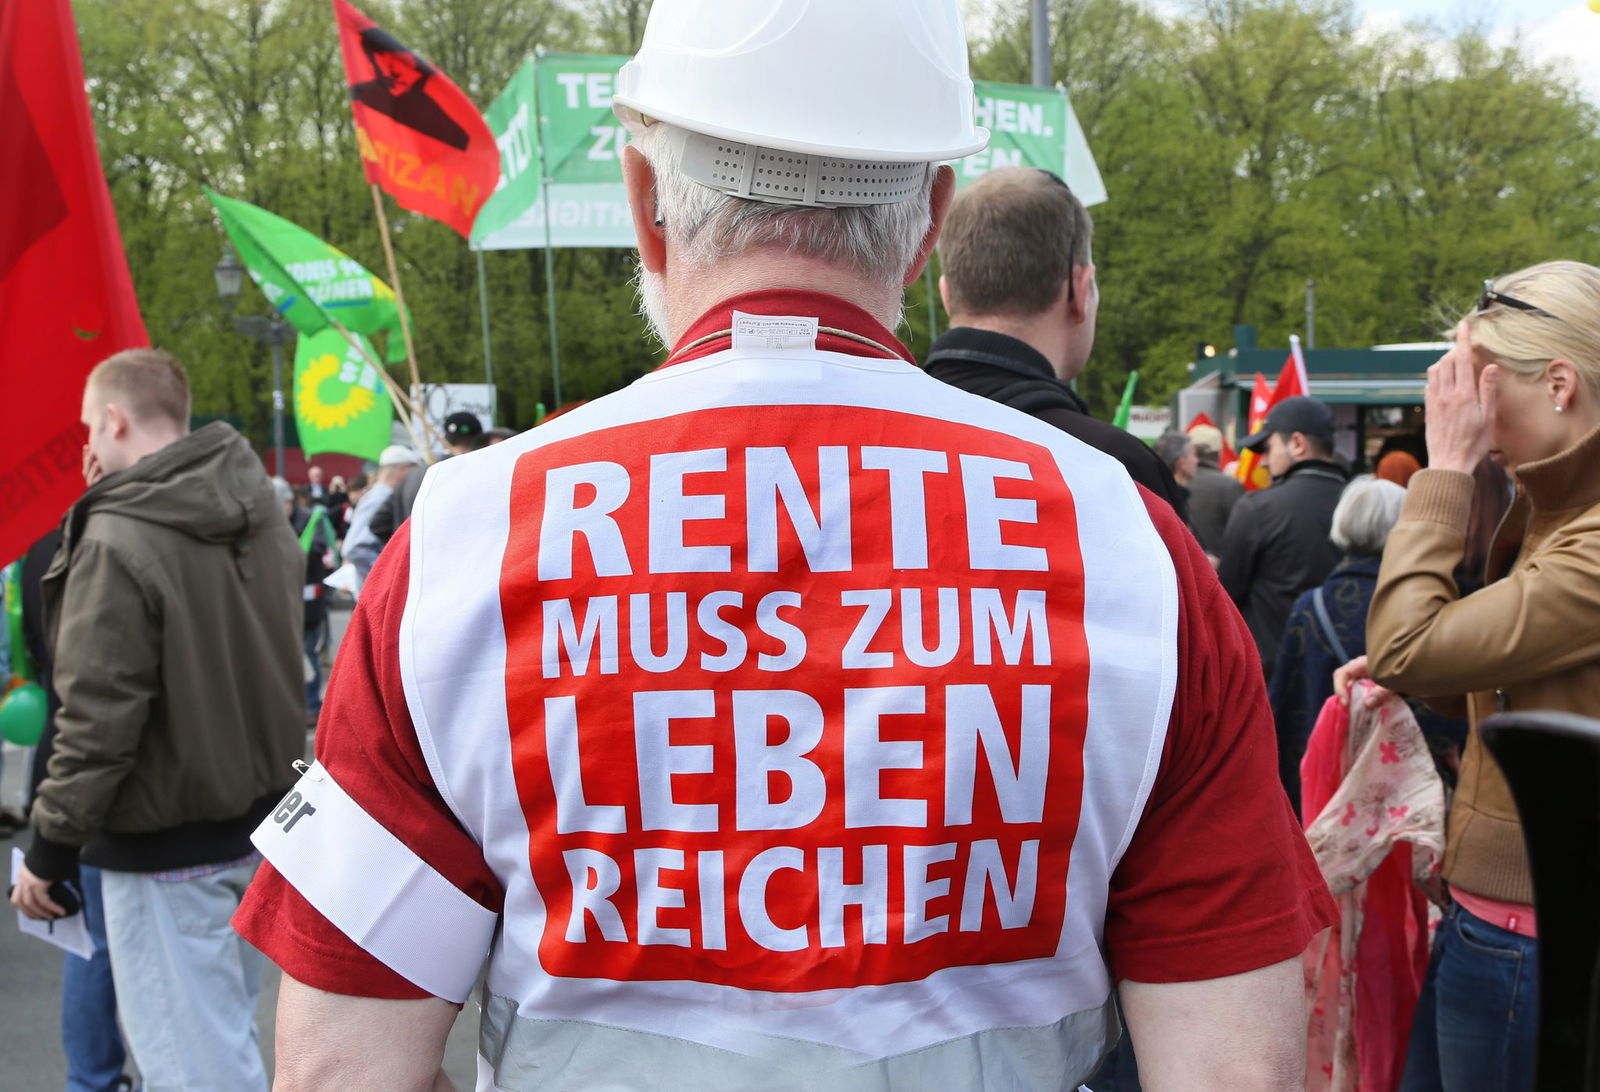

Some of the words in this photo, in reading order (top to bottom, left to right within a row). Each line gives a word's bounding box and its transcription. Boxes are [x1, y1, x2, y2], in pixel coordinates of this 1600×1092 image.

[556, 72, 620, 109] TE
[537, 445, 1049, 581] RENTE
[542, 590, 807, 679] MUSS
[841, 587, 1052, 670] ZUM
[544, 684, 1052, 834] LEBEN
[271, 787, 317, 834] er
[562, 839, 1040, 952] REICHEN
